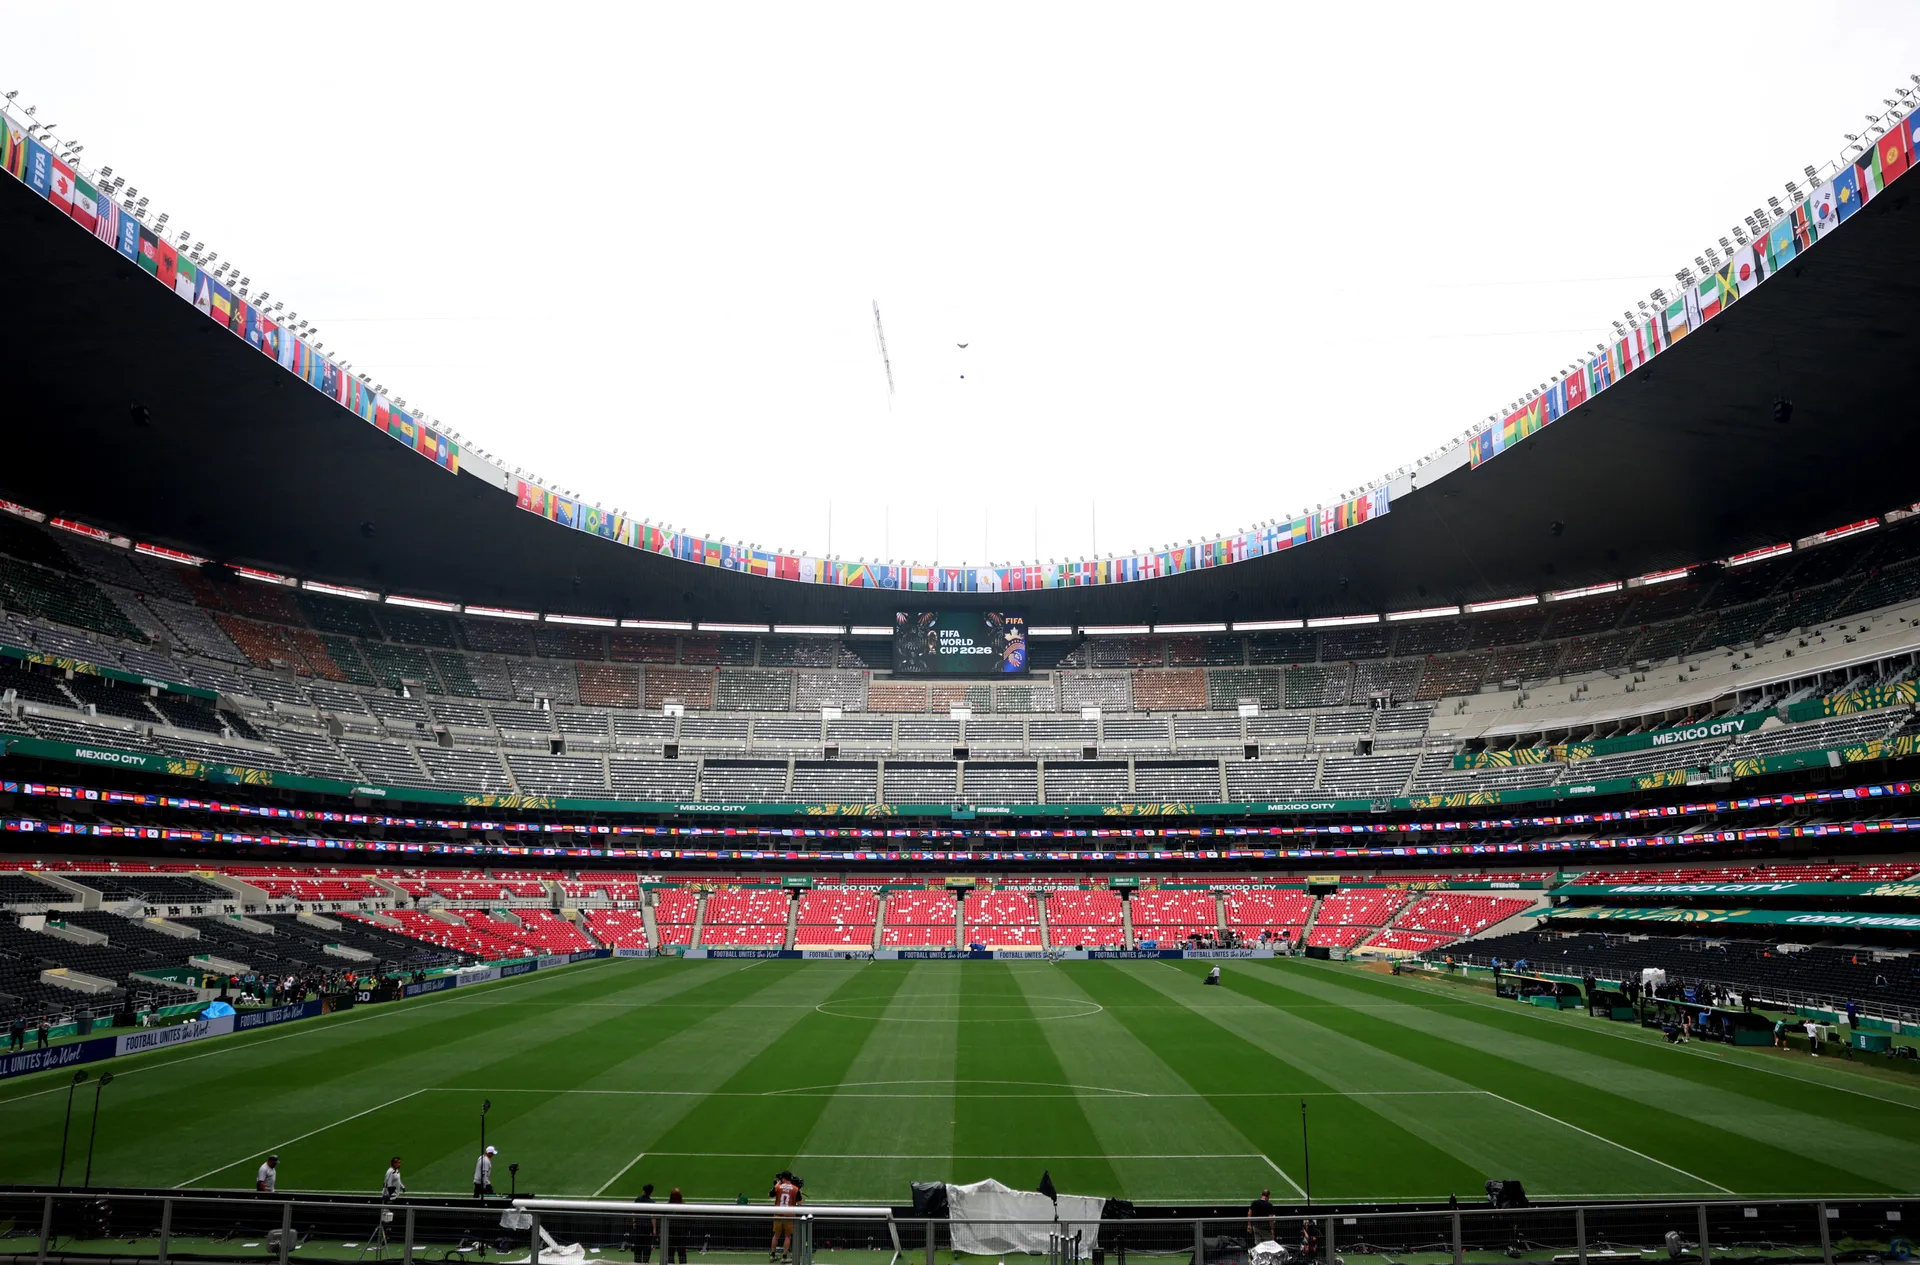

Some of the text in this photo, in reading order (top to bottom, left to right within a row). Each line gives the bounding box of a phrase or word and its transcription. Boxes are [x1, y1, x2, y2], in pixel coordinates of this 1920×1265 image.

[34, 152, 46, 188] FIFA
[124, 221, 134, 254] FIFA
[1652, 720, 1744, 745] MEXICO CITY
[76, 749, 146, 765] MEXICO CITY
[1786, 915, 1854, 923] COPA
[240, 1013, 264, 1027] FOOTBALL
[266, 1009, 281, 1023] UNITES
[126, 1032, 157, 1050] FOOTBALL
[160, 1028, 181, 1043] UNITES
[182, 1025, 192, 1040] the
[11, 1052, 41, 1072] UNITES
[43, 1049, 58, 1067] the
